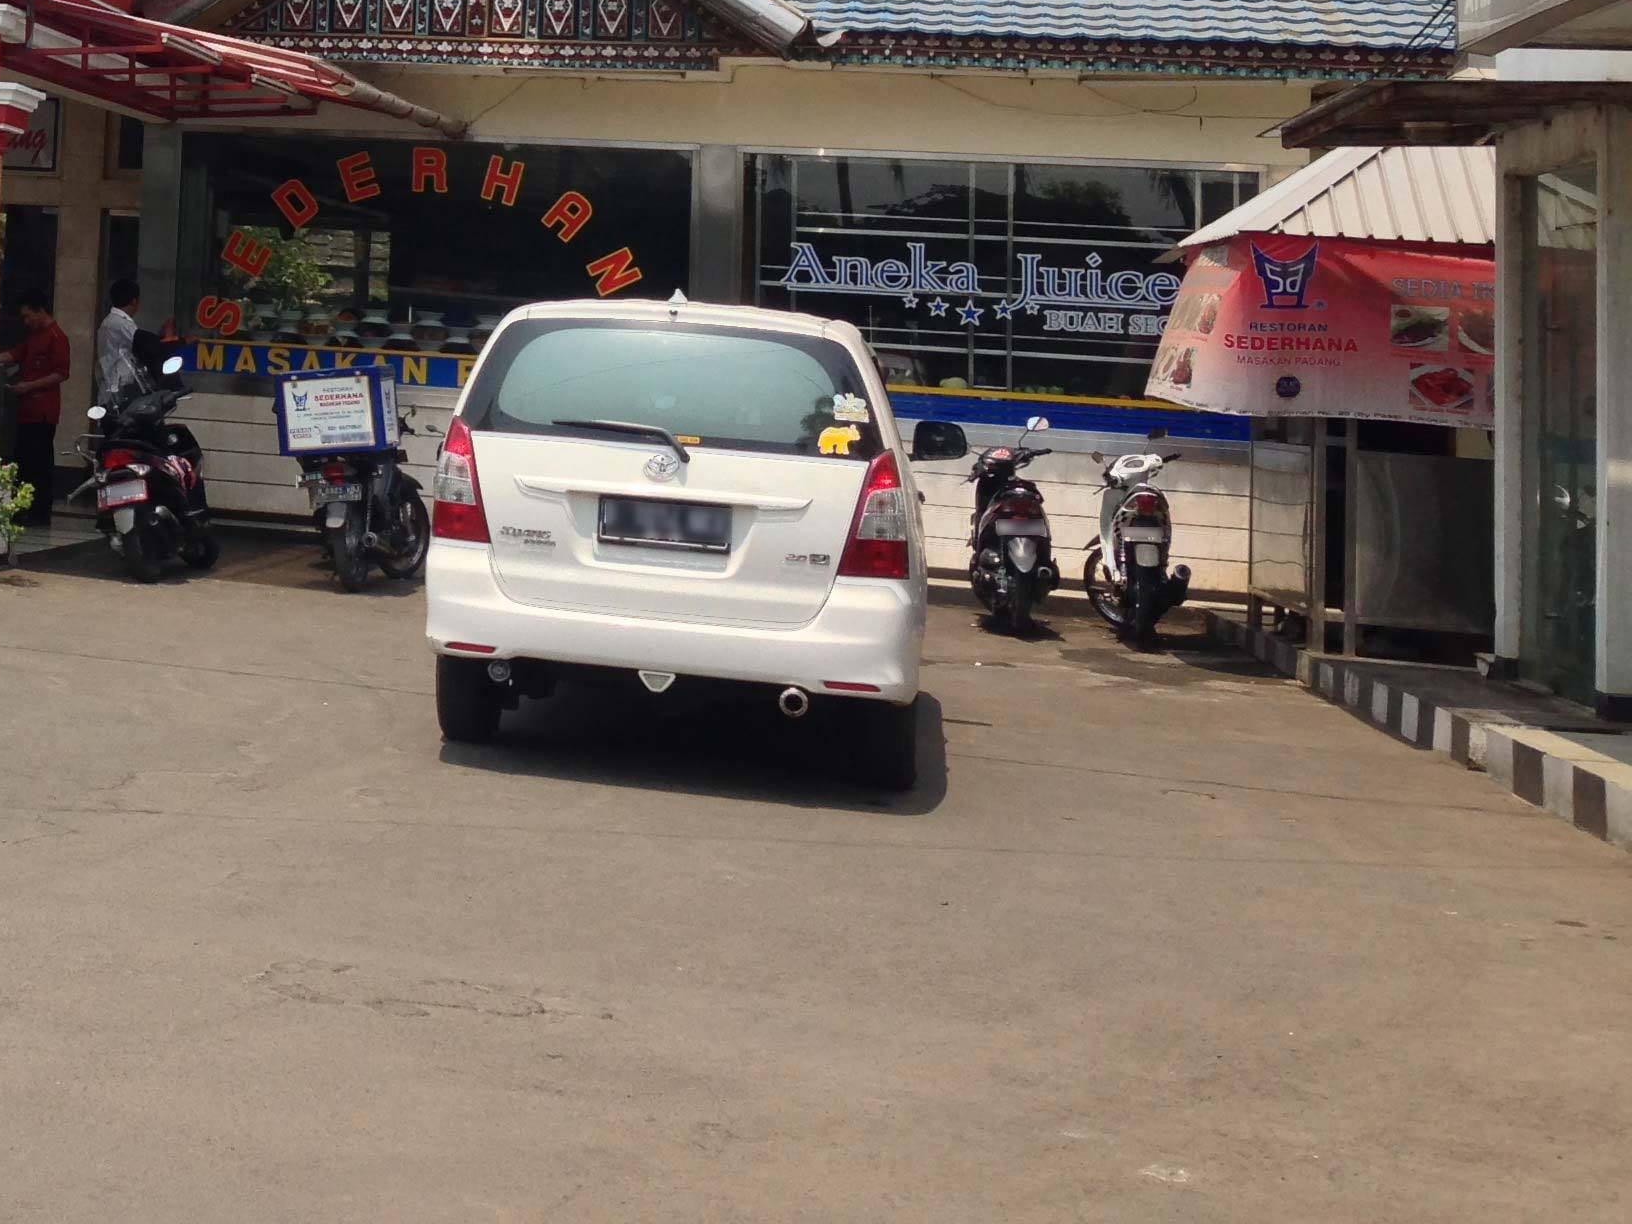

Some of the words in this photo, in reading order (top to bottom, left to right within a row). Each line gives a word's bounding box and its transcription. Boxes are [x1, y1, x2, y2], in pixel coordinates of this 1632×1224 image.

[197, 147, 642, 336] SEDERHAN
[780, 242, 981, 294] Aneka
[1391, 277, 1464, 299] SEDIA
[1043, 310, 1124, 333] BUAH
[1249, 322, 1328, 332] RESTORAN
[1224, 333, 1358, 353] SEDERHANA
[1236, 355, 1291, 366] MASAKAN
[1294, 357, 1341, 367] PADANG
[314, 392, 364, 402] SEDERHANA
